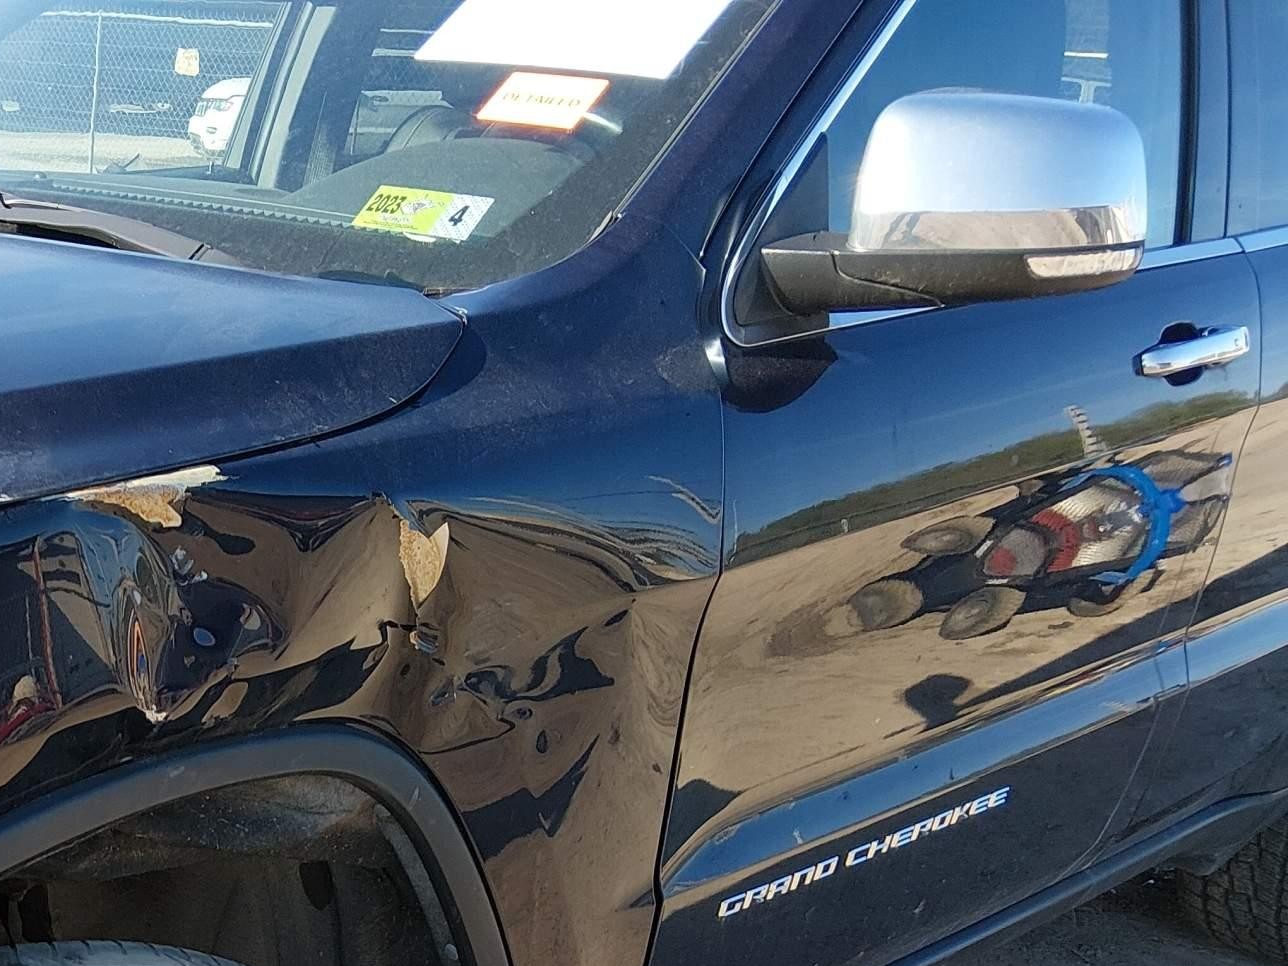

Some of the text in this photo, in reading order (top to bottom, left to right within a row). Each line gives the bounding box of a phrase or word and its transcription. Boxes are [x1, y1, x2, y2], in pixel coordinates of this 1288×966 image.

[448, 205, 470, 227] 4
[716, 785, 1011, 919] GRAND CHEROKEE
